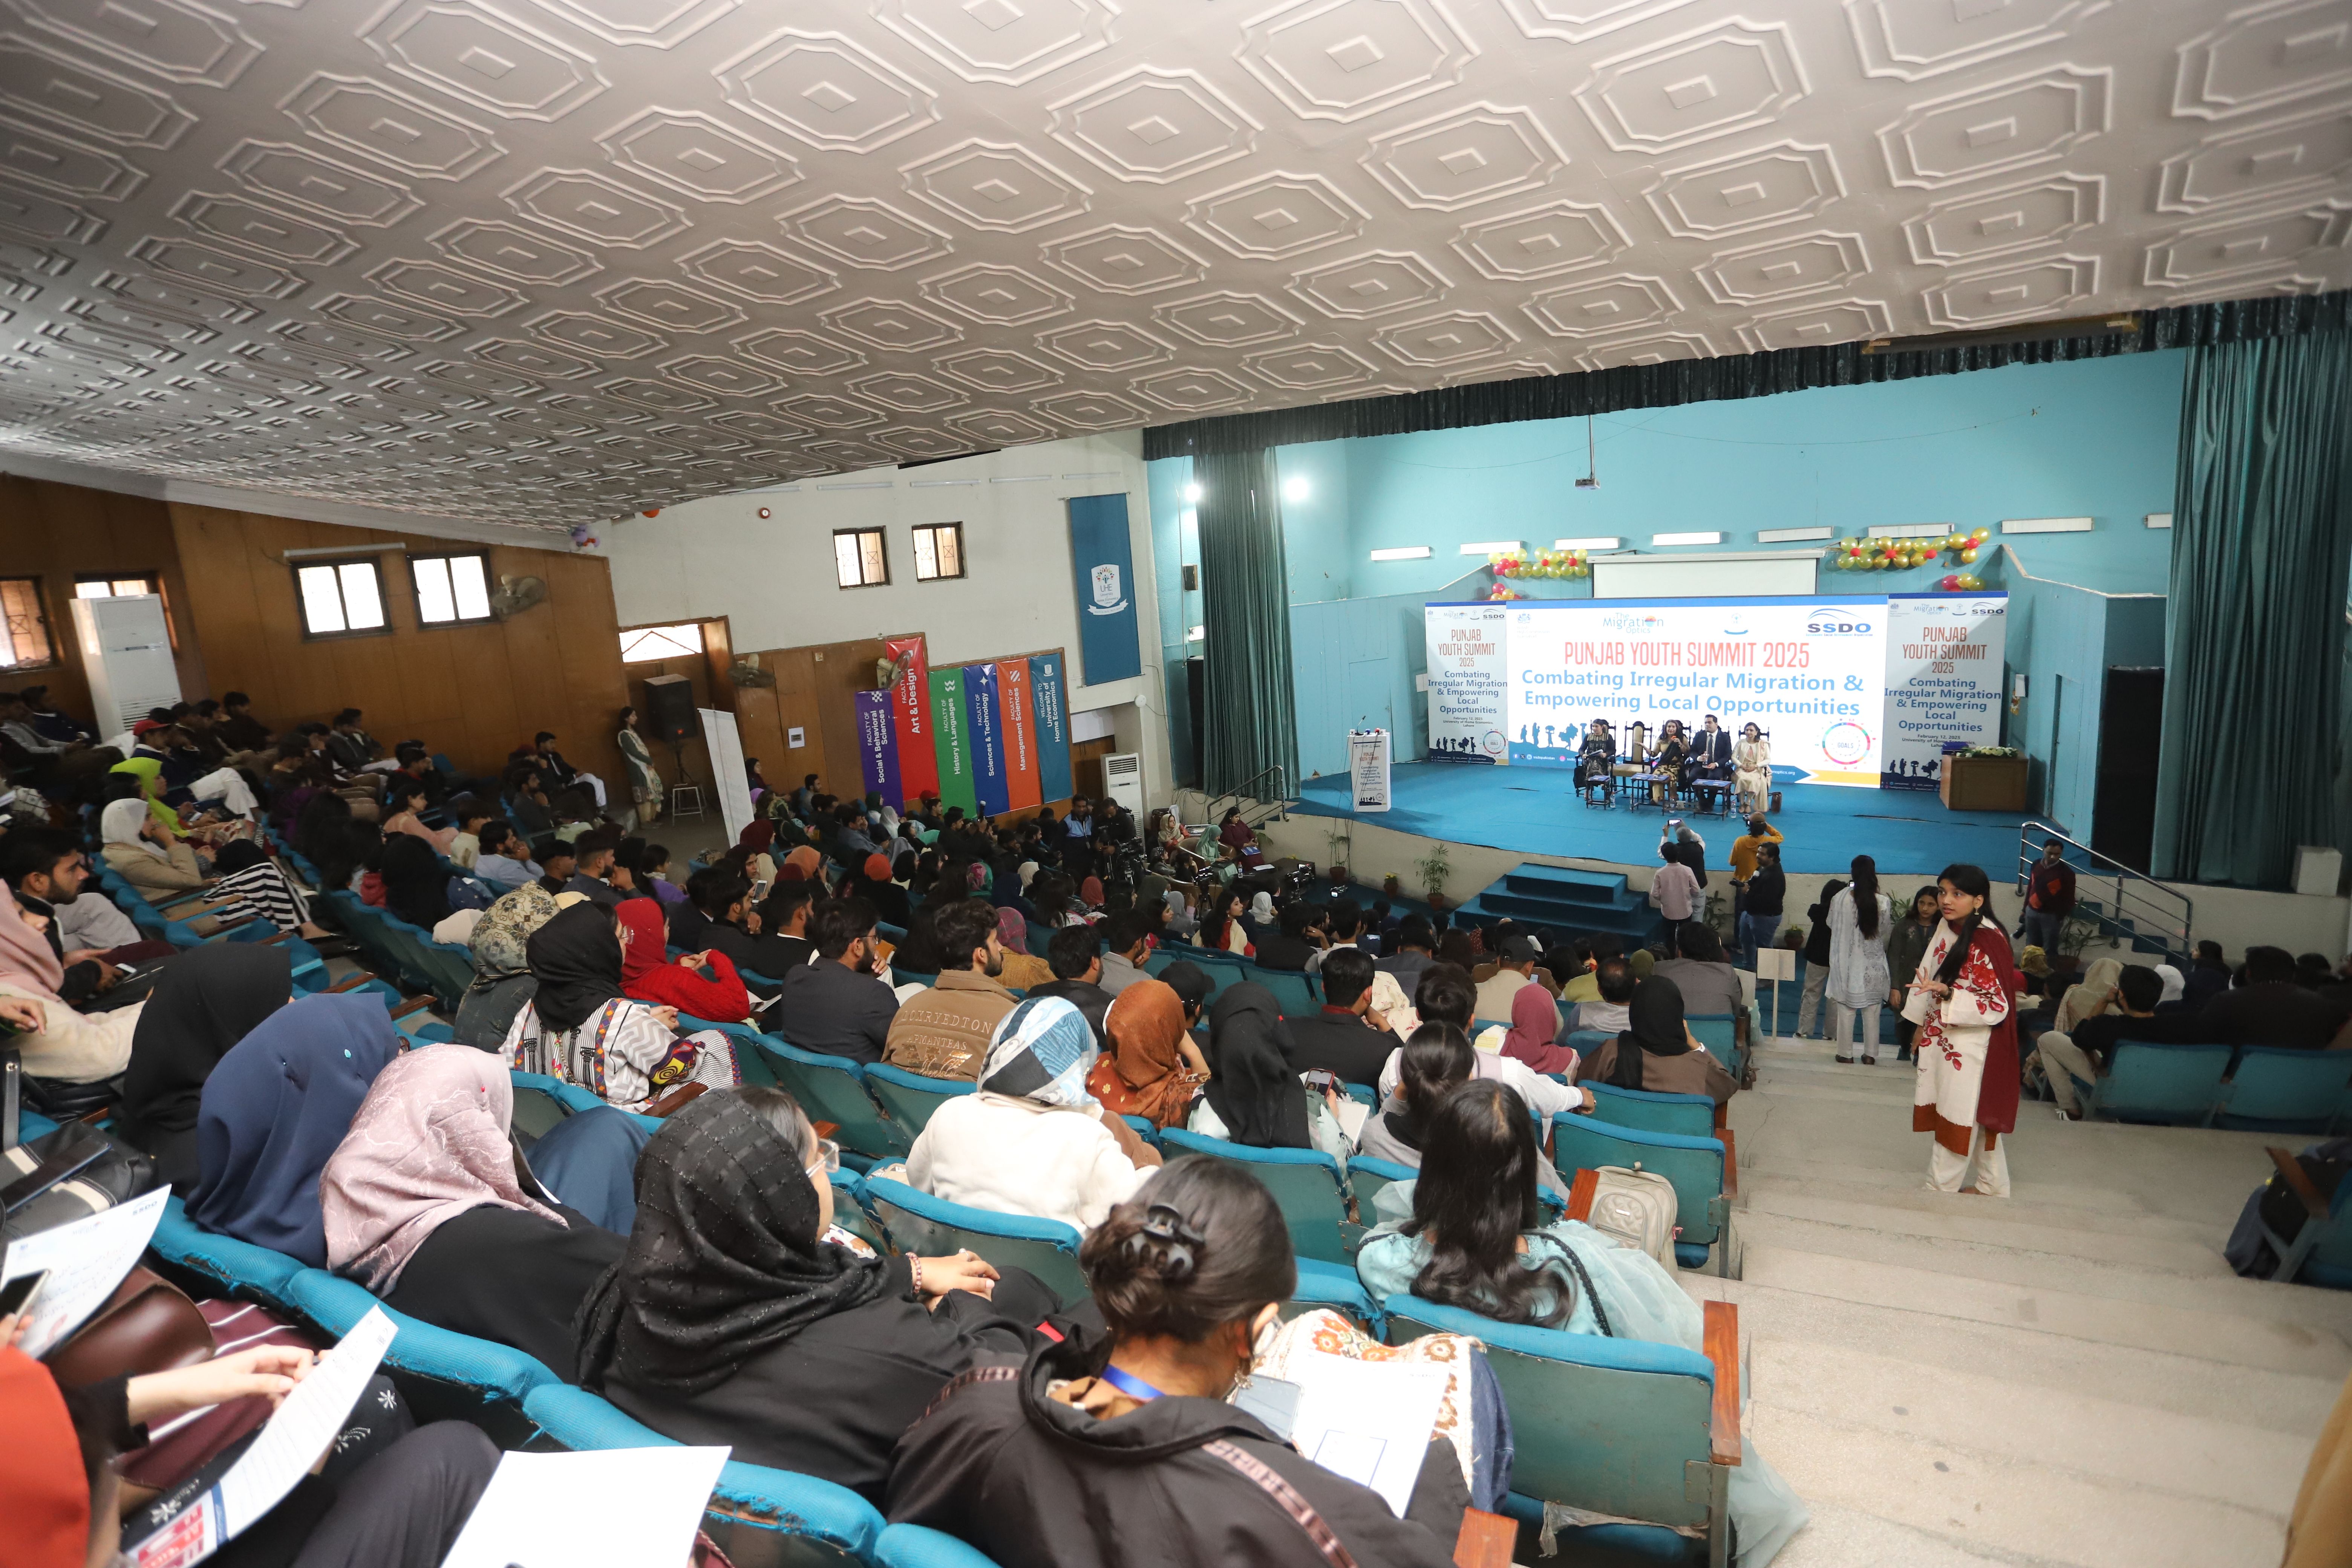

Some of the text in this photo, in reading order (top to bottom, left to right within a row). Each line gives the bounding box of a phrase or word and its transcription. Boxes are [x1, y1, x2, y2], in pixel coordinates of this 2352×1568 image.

[1100, 583, 1112, 592] UHE
[1452, 629, 1481, 641] PUNJAB
[1807, 623, 1871, 633] SSDO
[1923, 627, 1967, 642] PUNJAB
[1438, 643, 1495, 655] YOUTH SUMMIT
[1565, 642, 1809, 668] PUNJAB YOUTH SUMMIT 2025
[1902, 644, 1987, 660] YOUTH SUMMIT
[1459, 657, 1474, 667] 2025
[1932, 662, 1954, 673] 2025
[1444, 671, 1490, 680] Combating
[1522, 669, 1864, 694] Combating Irregular Migration &
[906, 668, 917, 706] Design
[1428, 680, 1507, 689] Irregular Migration
[1909, 678, 1976, 690] Combating
[1050, 681, 1058, 720] Economics
[1447, 689, 1499, 698] Empowering
[1885, 688, 2001, 701] Irregular Migration
[1044, 691, 1053, 727] University
[1440, 706, 1497, 714] Opportunities
[1525, 691, 1860, 716] Empowering Local Opportunities
[1897, 699, 1987, 712] & Empowering
[948, 698, 957, 740] Languages
[982, 693, 991, 736] Technology
[1925, 711, 1956, 720] Local
[870, 710, 881, 752] Behavioral
[879, 709, 888, 745] Sciences
[911, 717, 920, 733] Art
[1899, 720, 1982, 732] Opportunities
[1017, 722, 1026, 771] Management
[876, 760, 885, 783] Social
[132, 1200, 158, 1216] SSDO
